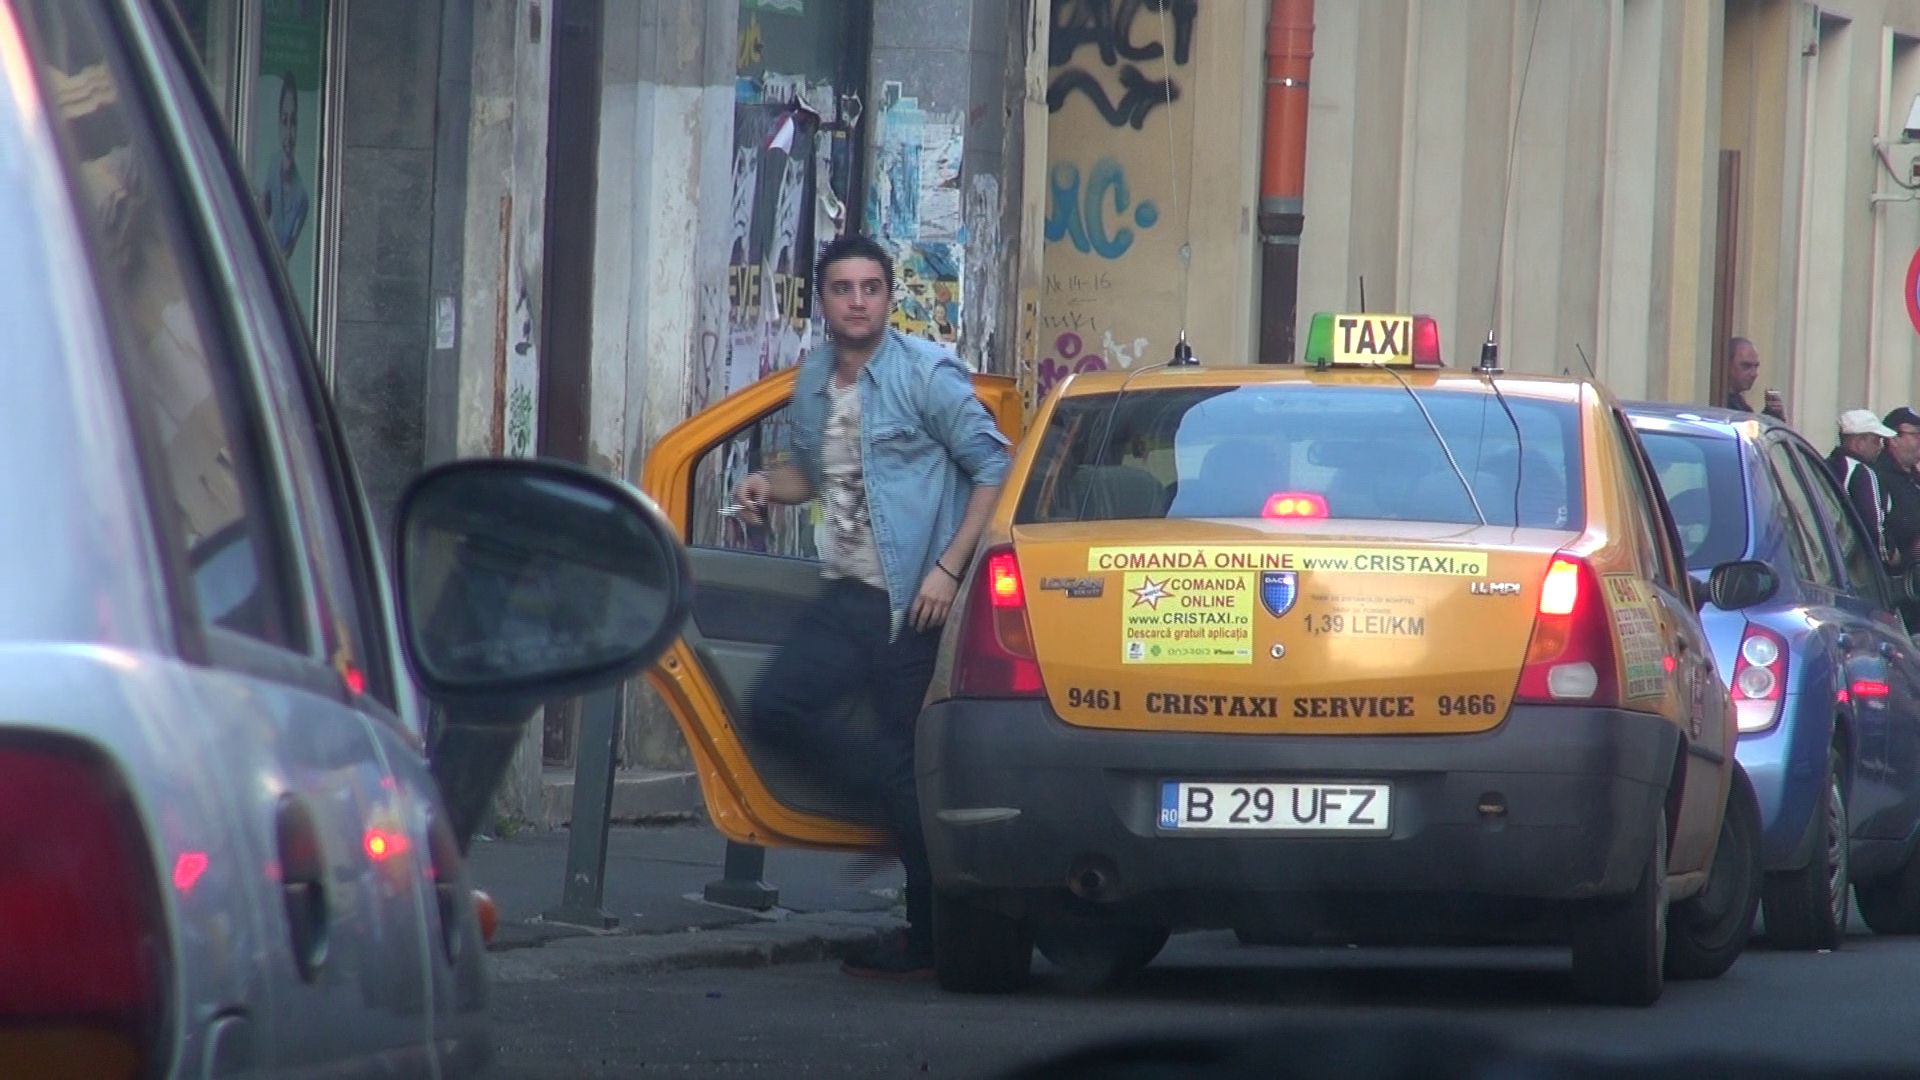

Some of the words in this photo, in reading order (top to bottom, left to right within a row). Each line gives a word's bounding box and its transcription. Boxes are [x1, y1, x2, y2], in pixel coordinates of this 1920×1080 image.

[1339, 318, 1410, 356] TAXI
[1098, 550, 1208, 570] COMANDĂ
[1214, 552, 1294, 570] ONLINE
[1302, 554, 1480, 575] www.CRISTAXI.ro
[1171, 576, 1246, 591] COMANDĂ
[1180, 595, 1236, 608] ONLINE
[1128, 612, 1249, 625] www.CRISTAXI.ro
[1303, 613, 1345, 636] 1,39
[1352, 615, 1425, 637] LEI/KM
[1127, 627, 1172, 639] Descarcă
[1174, 627, 1206, 641] gratuit
[1067, 687, 1122, 711] 9461
[1145, 691, 1279, 718] CRISTAXI
[1293, 696, 1416, 718] SERVICE
[1437, 693, 1497, 717] 9466
[1186, 786, 1215, 823] B
[1228, 787, 1275, 824] 29
[1291, 787, 1377, 825] UFZ
[1160, 808, 1178, 823] RO
